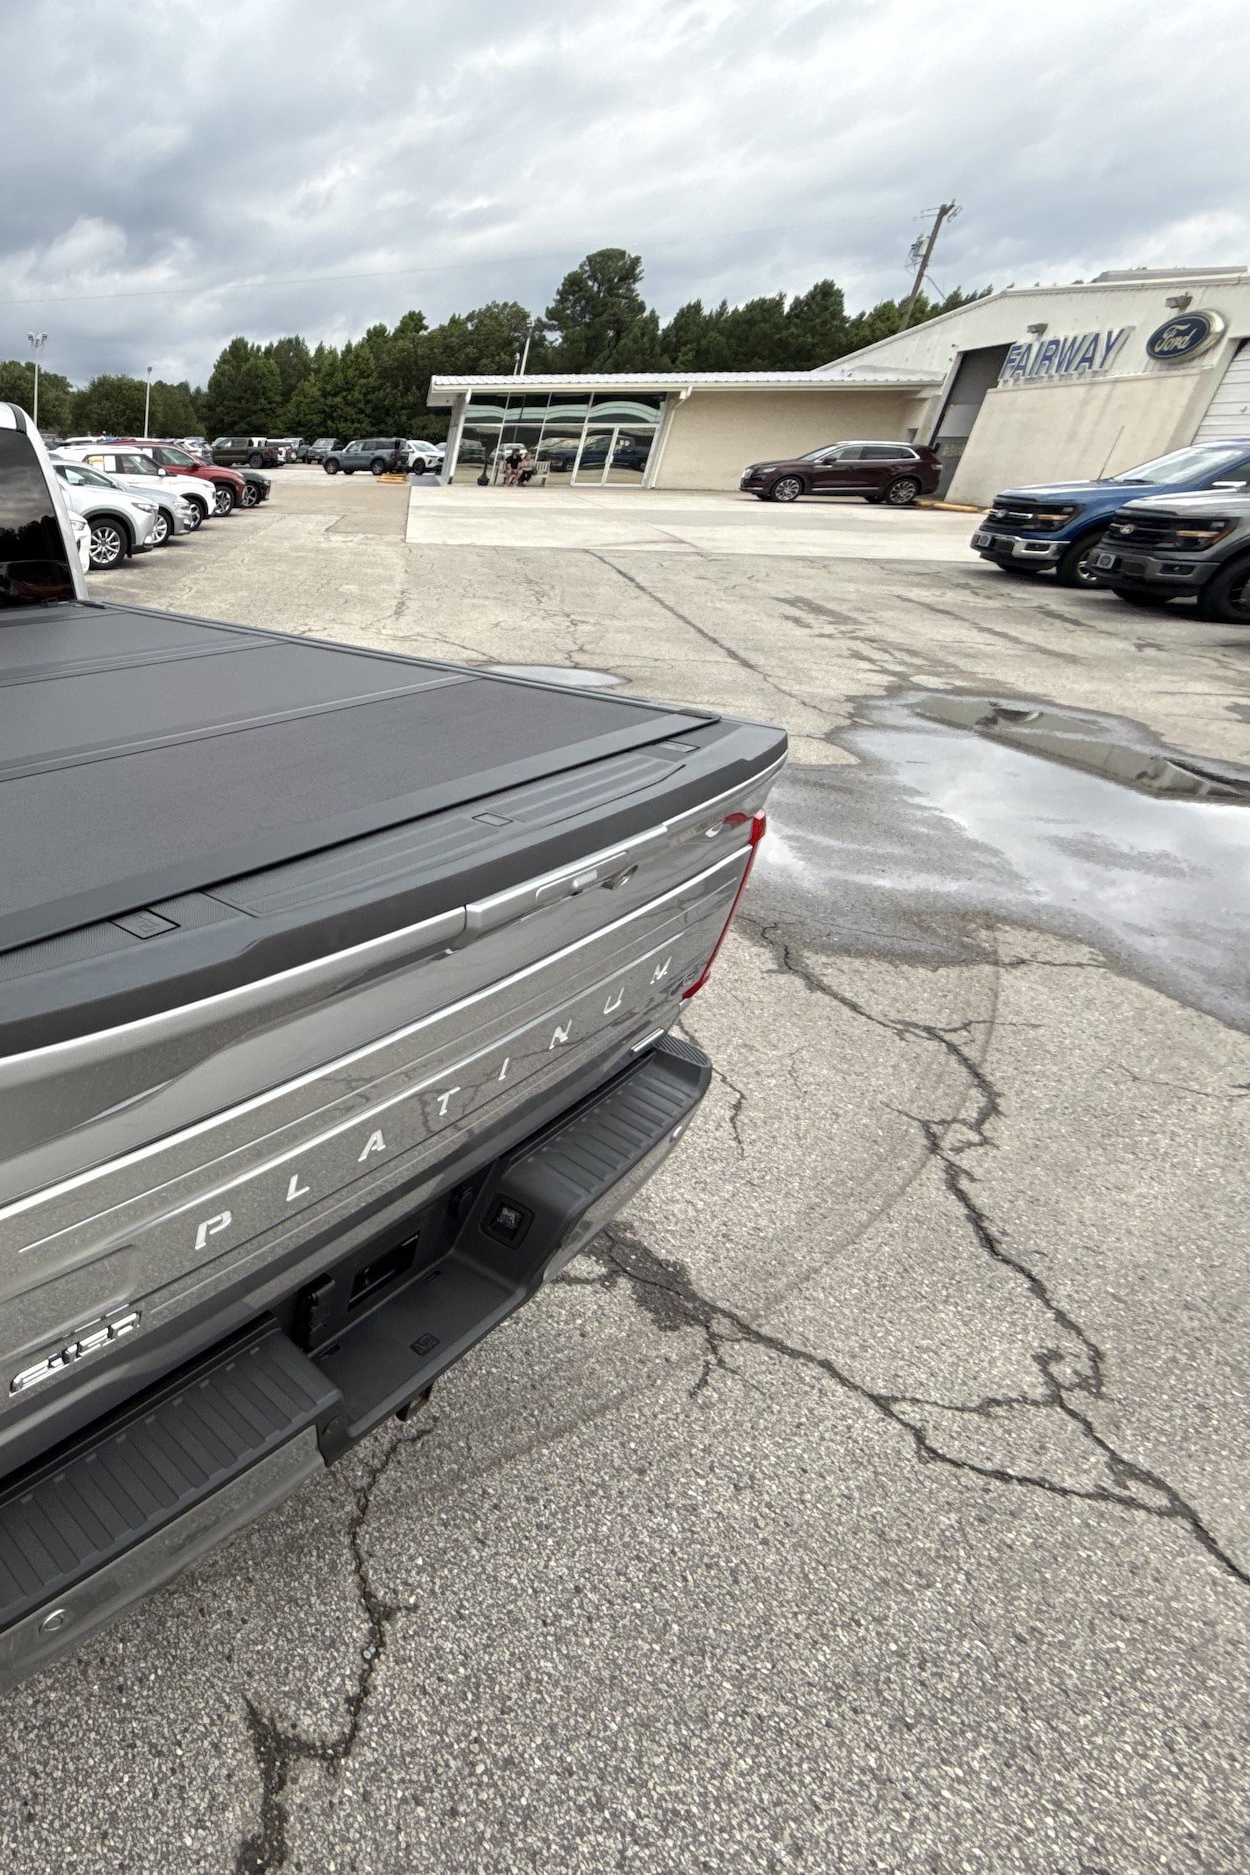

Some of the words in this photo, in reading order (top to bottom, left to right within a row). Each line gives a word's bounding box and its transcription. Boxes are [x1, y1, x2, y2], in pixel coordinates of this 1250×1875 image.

[1000, 327, 1128, 379] FAIRWAY
[1155, 323, 1198, 352] Ford
[194, 955, 672, 1250] PLATINUM
